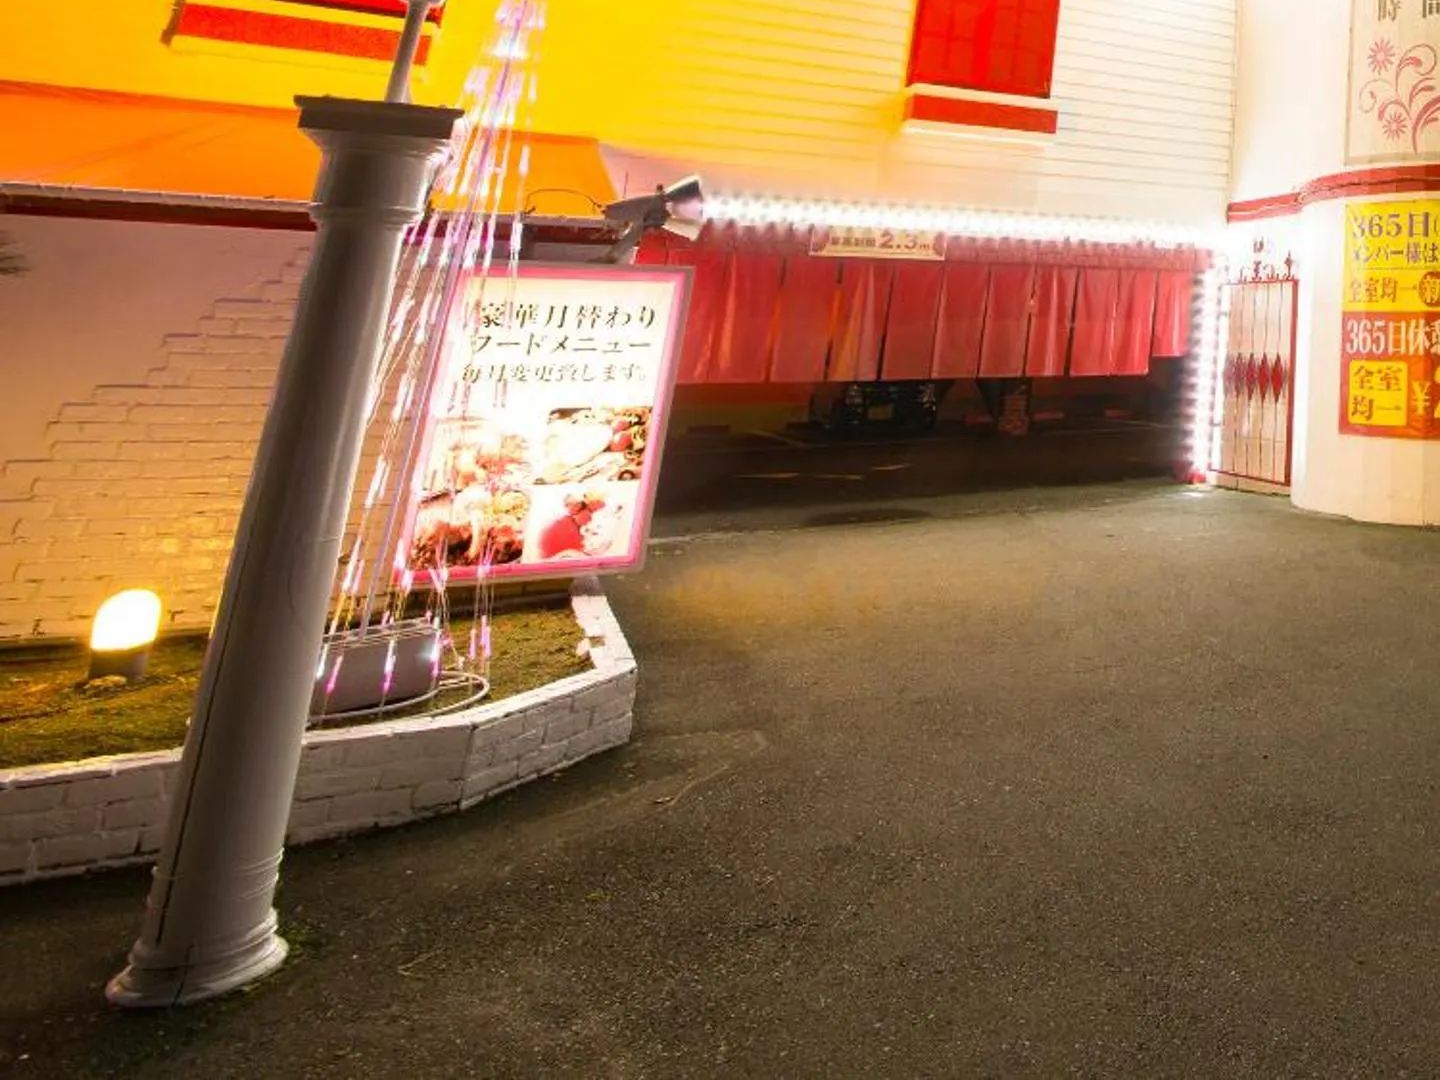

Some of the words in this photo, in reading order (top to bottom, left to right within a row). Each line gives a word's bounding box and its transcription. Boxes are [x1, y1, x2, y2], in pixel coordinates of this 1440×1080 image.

[1352, 212, 1430, 239] 365日
[475, 332, 651, 356] フードメニュー
